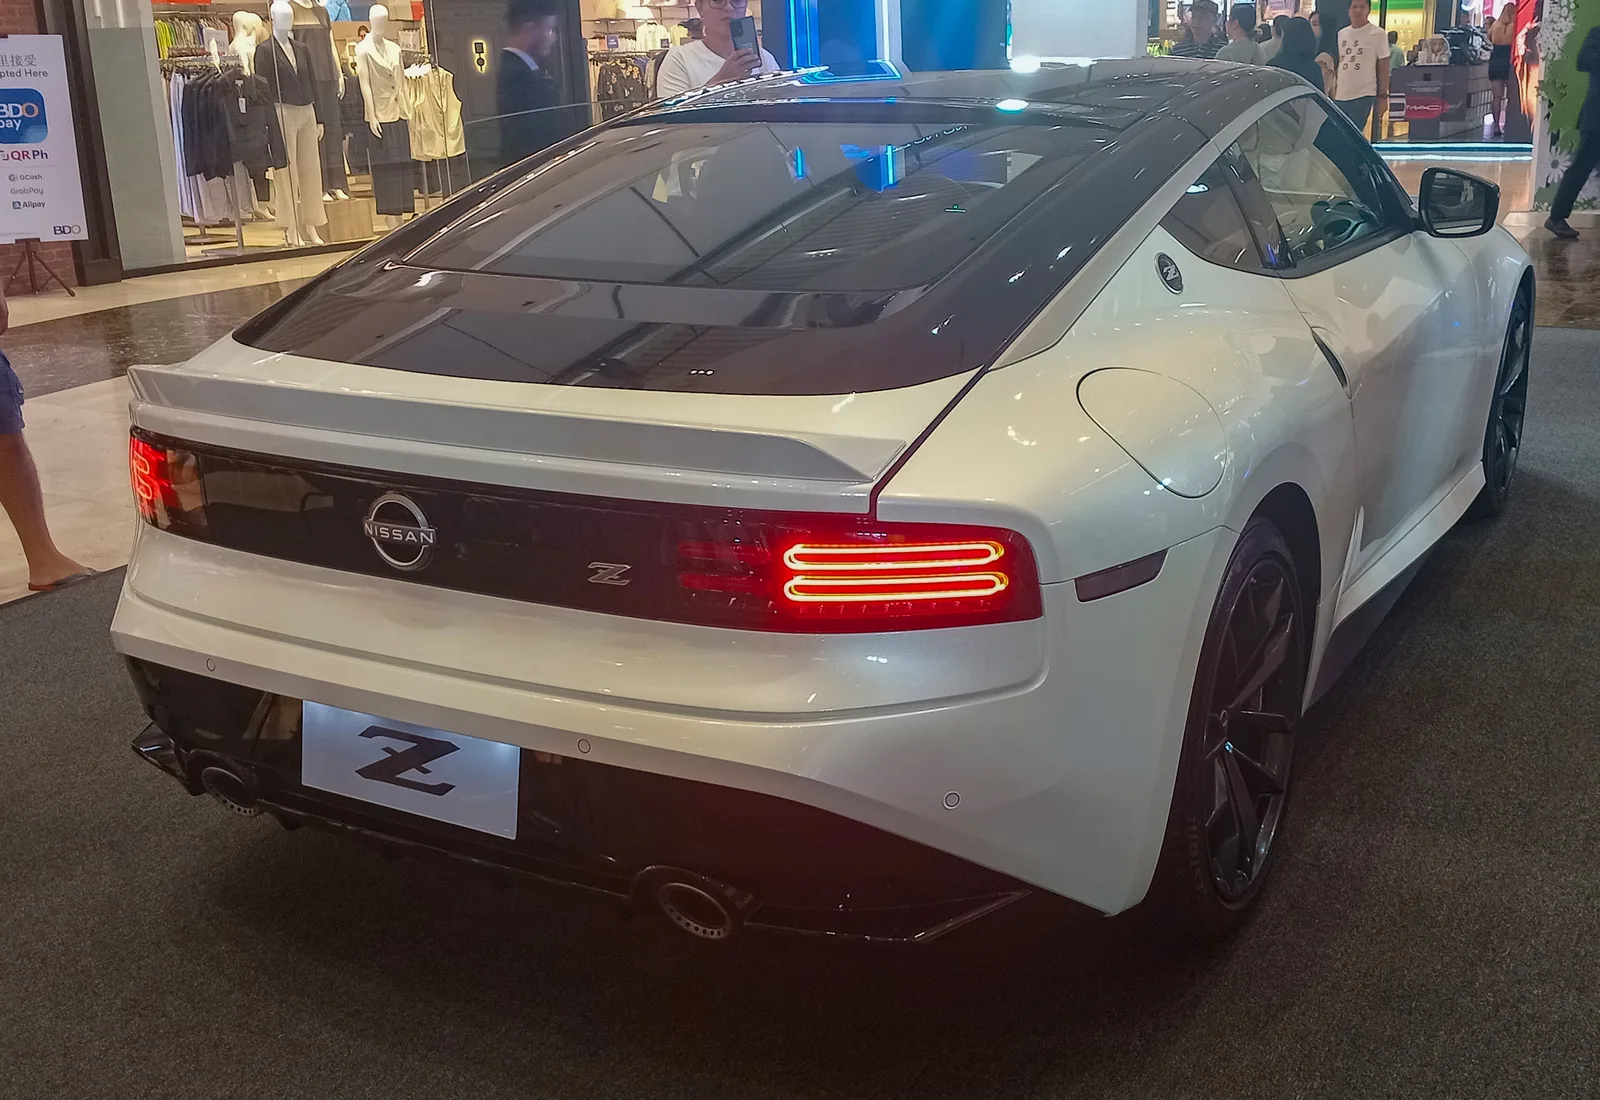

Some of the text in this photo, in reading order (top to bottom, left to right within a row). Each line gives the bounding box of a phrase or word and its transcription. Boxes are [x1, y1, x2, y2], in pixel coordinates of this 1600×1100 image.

[25, 69, 48, 78] Here
[0, 102, 39, 118] BDO
[53, 224, 82, 235] BDO
[364, 522, 434, 544] NISSAN
[588, 562, 632, 586] Z
[355, 725, 461, 796] Z
